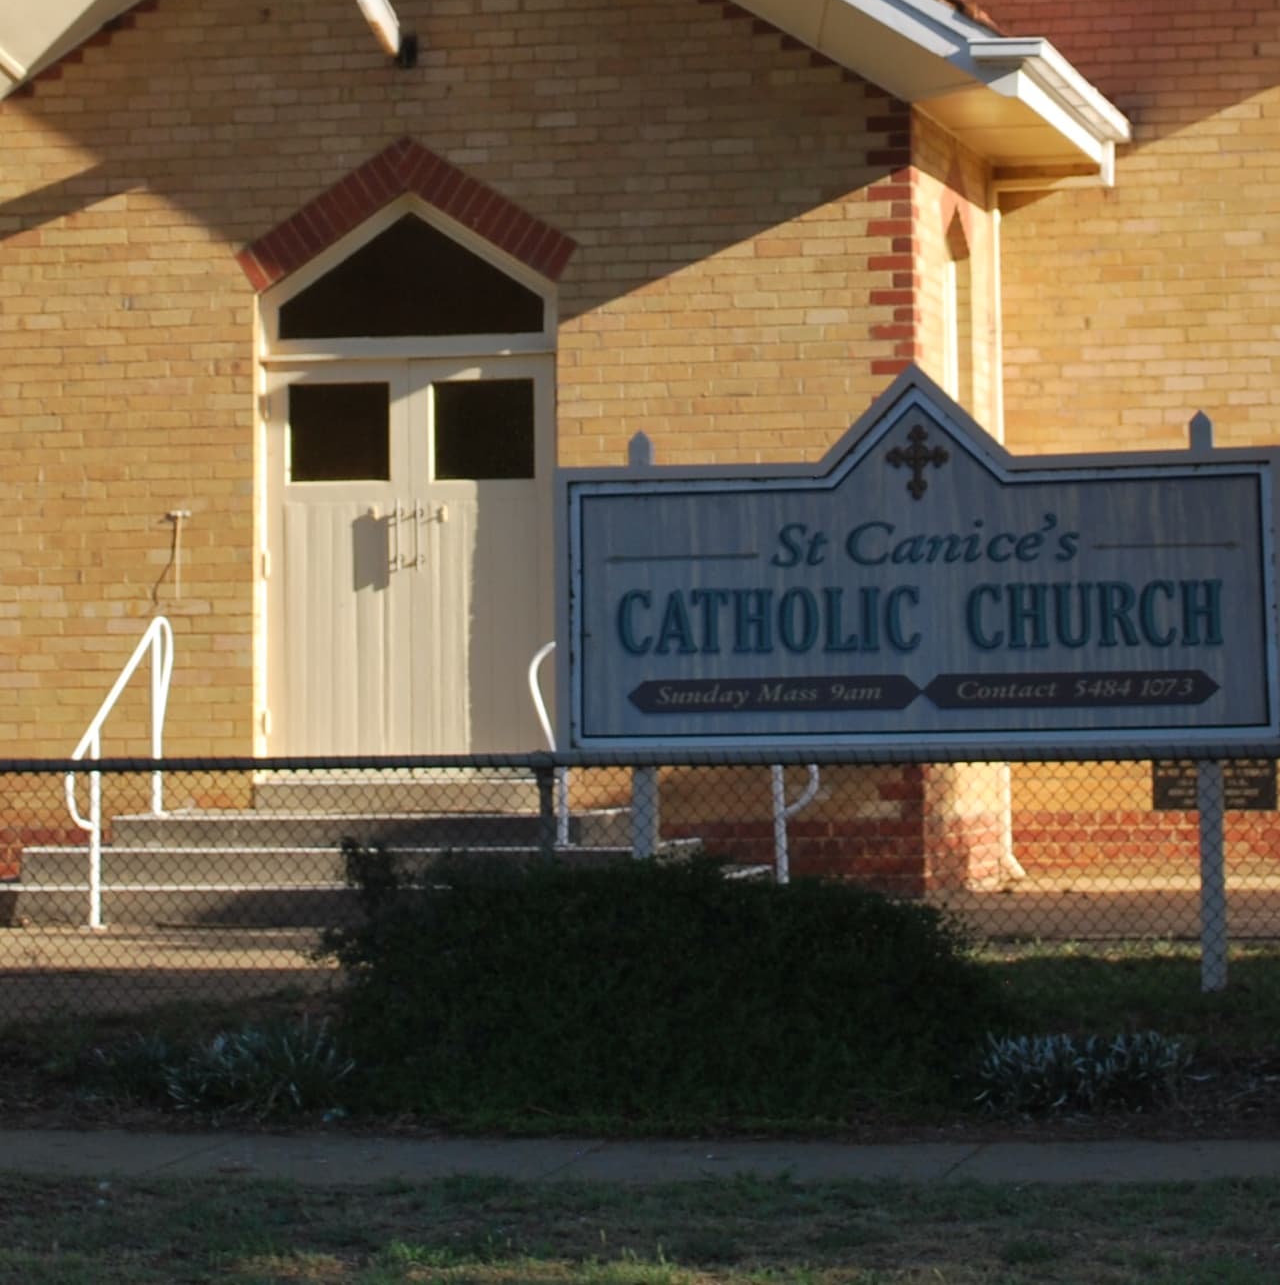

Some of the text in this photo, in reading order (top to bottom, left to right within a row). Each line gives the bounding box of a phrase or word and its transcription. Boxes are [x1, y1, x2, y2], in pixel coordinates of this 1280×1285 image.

[770, 512, 1080, 568] St Canice's
[616, 578, 1224, 655] CATHOLIC CHURCH
[656, 682, 882, 708] Sunday Mass 9am
[956, 678, 1194, 700] Contact 5484 1073
